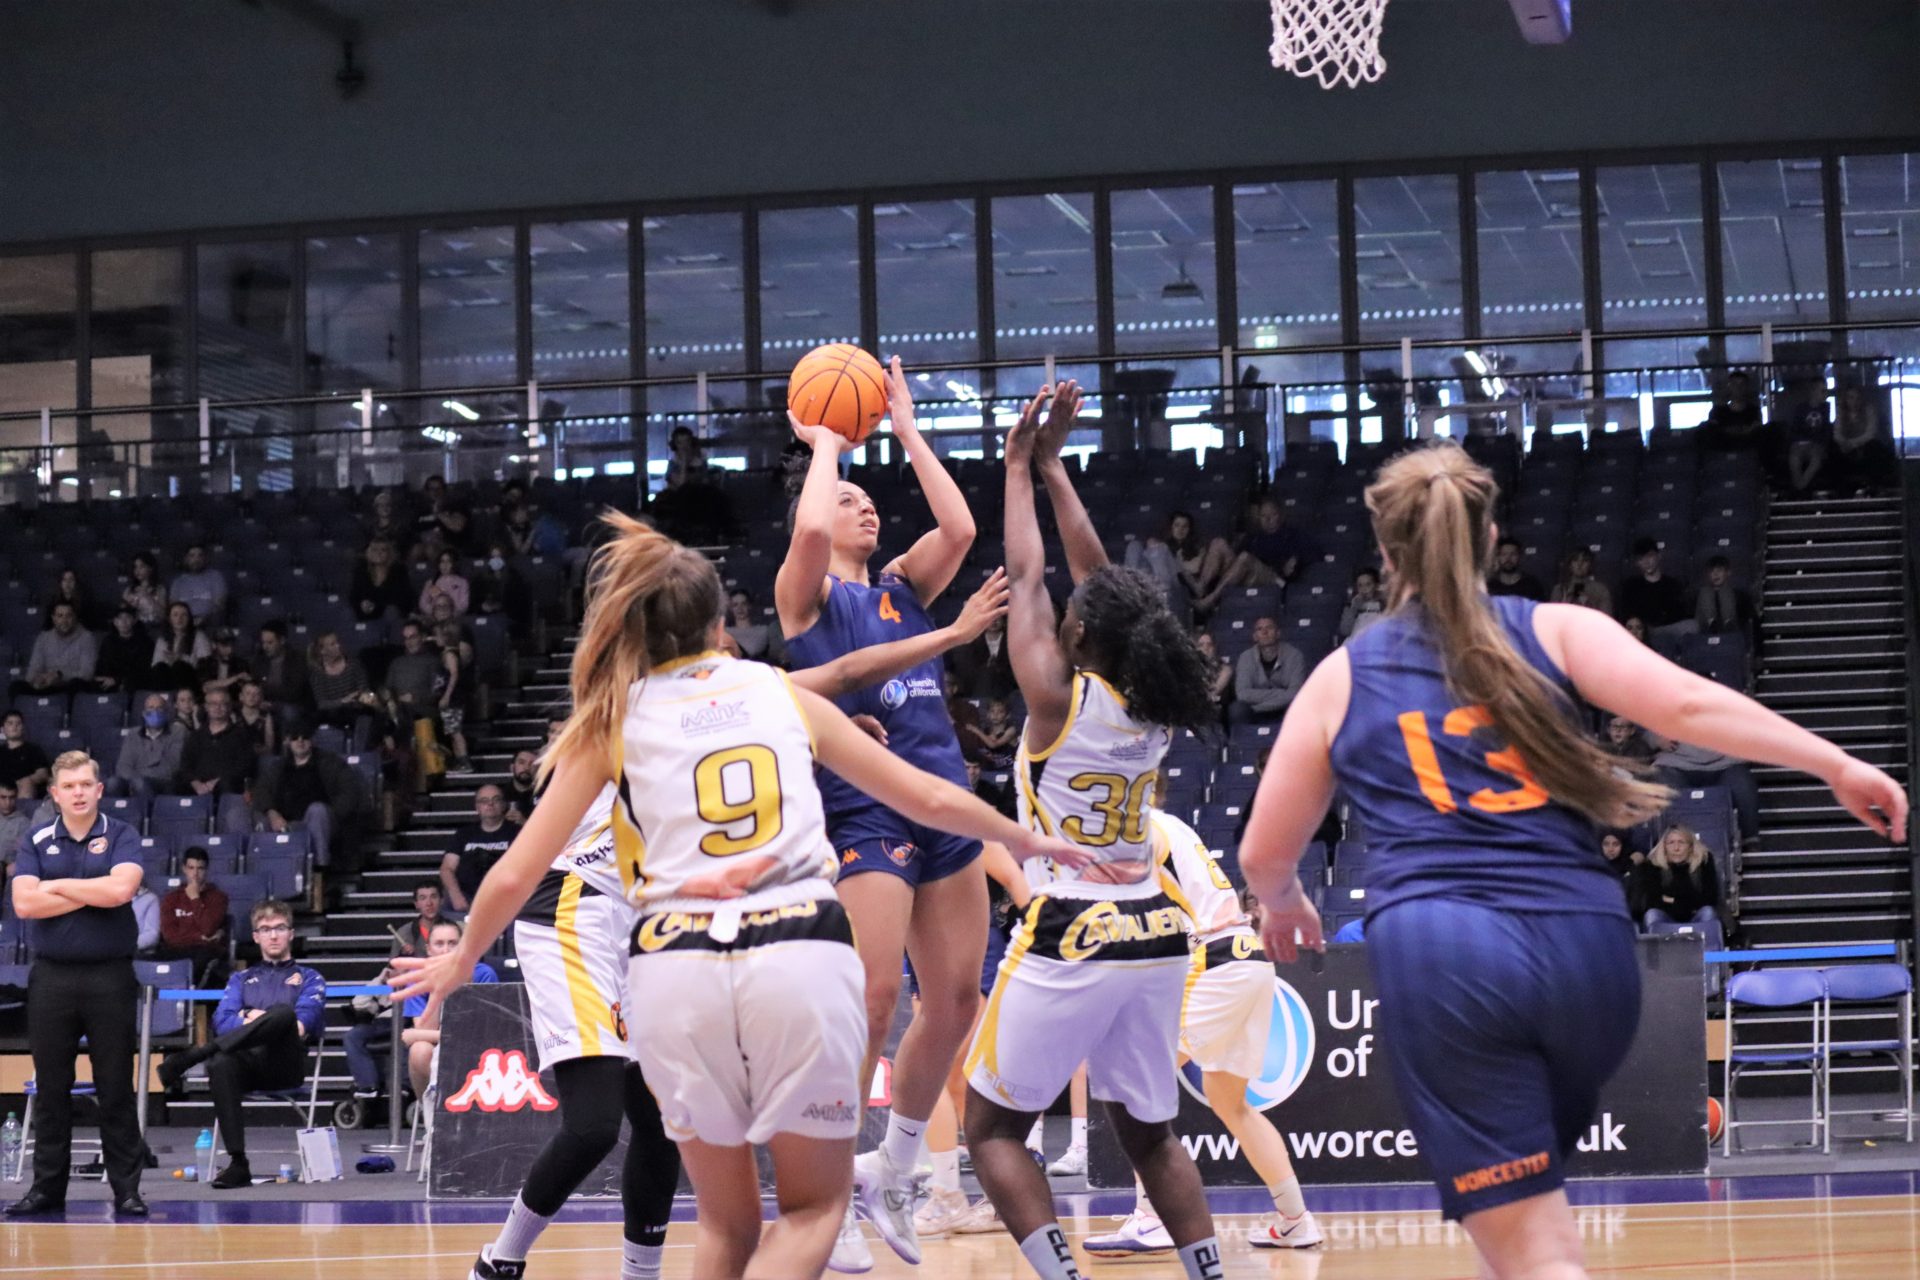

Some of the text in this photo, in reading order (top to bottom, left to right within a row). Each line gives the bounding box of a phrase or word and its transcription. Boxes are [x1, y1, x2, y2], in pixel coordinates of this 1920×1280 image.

[879, 591, 902, 623] 4
[1397, 704, 1549, 814] 13
[694, 743, 783, 858] 9
[1060, 771, 1157, 847] 30
[1058, 900, 1186, 961] CAVALIER
[1326, 1033, 1374, 1078] of
[1288, 1129, 1419, 1159] worce
[1576, 1112, 1627, 1152] uk
[1452, 1151, 1550, 1195] WORCESTER
